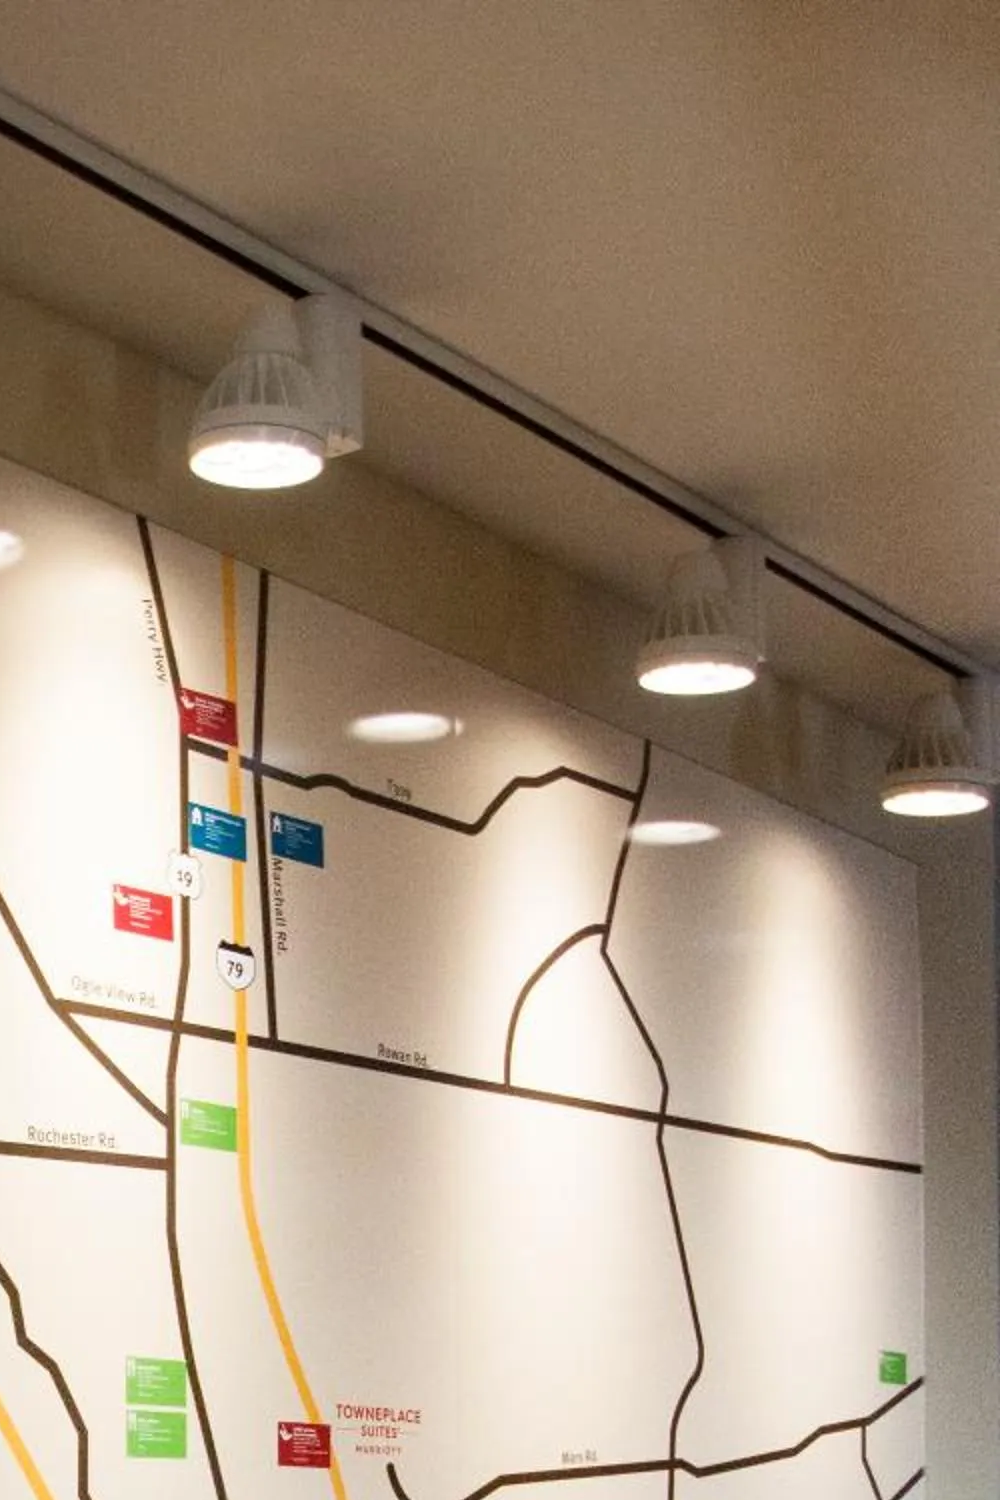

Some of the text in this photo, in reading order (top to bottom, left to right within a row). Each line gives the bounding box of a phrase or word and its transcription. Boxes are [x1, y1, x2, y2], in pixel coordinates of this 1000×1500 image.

[176, 870, 194, 889] 19
[272, 857, 287, 928] Marshall
[226, 960, 244, 978] 79
[27, 1125, 96, 1146] Rochester
[336, 1403, 422, 1425] TOWNEPLACE
[361, 1425, 398, 1439] SUITES
